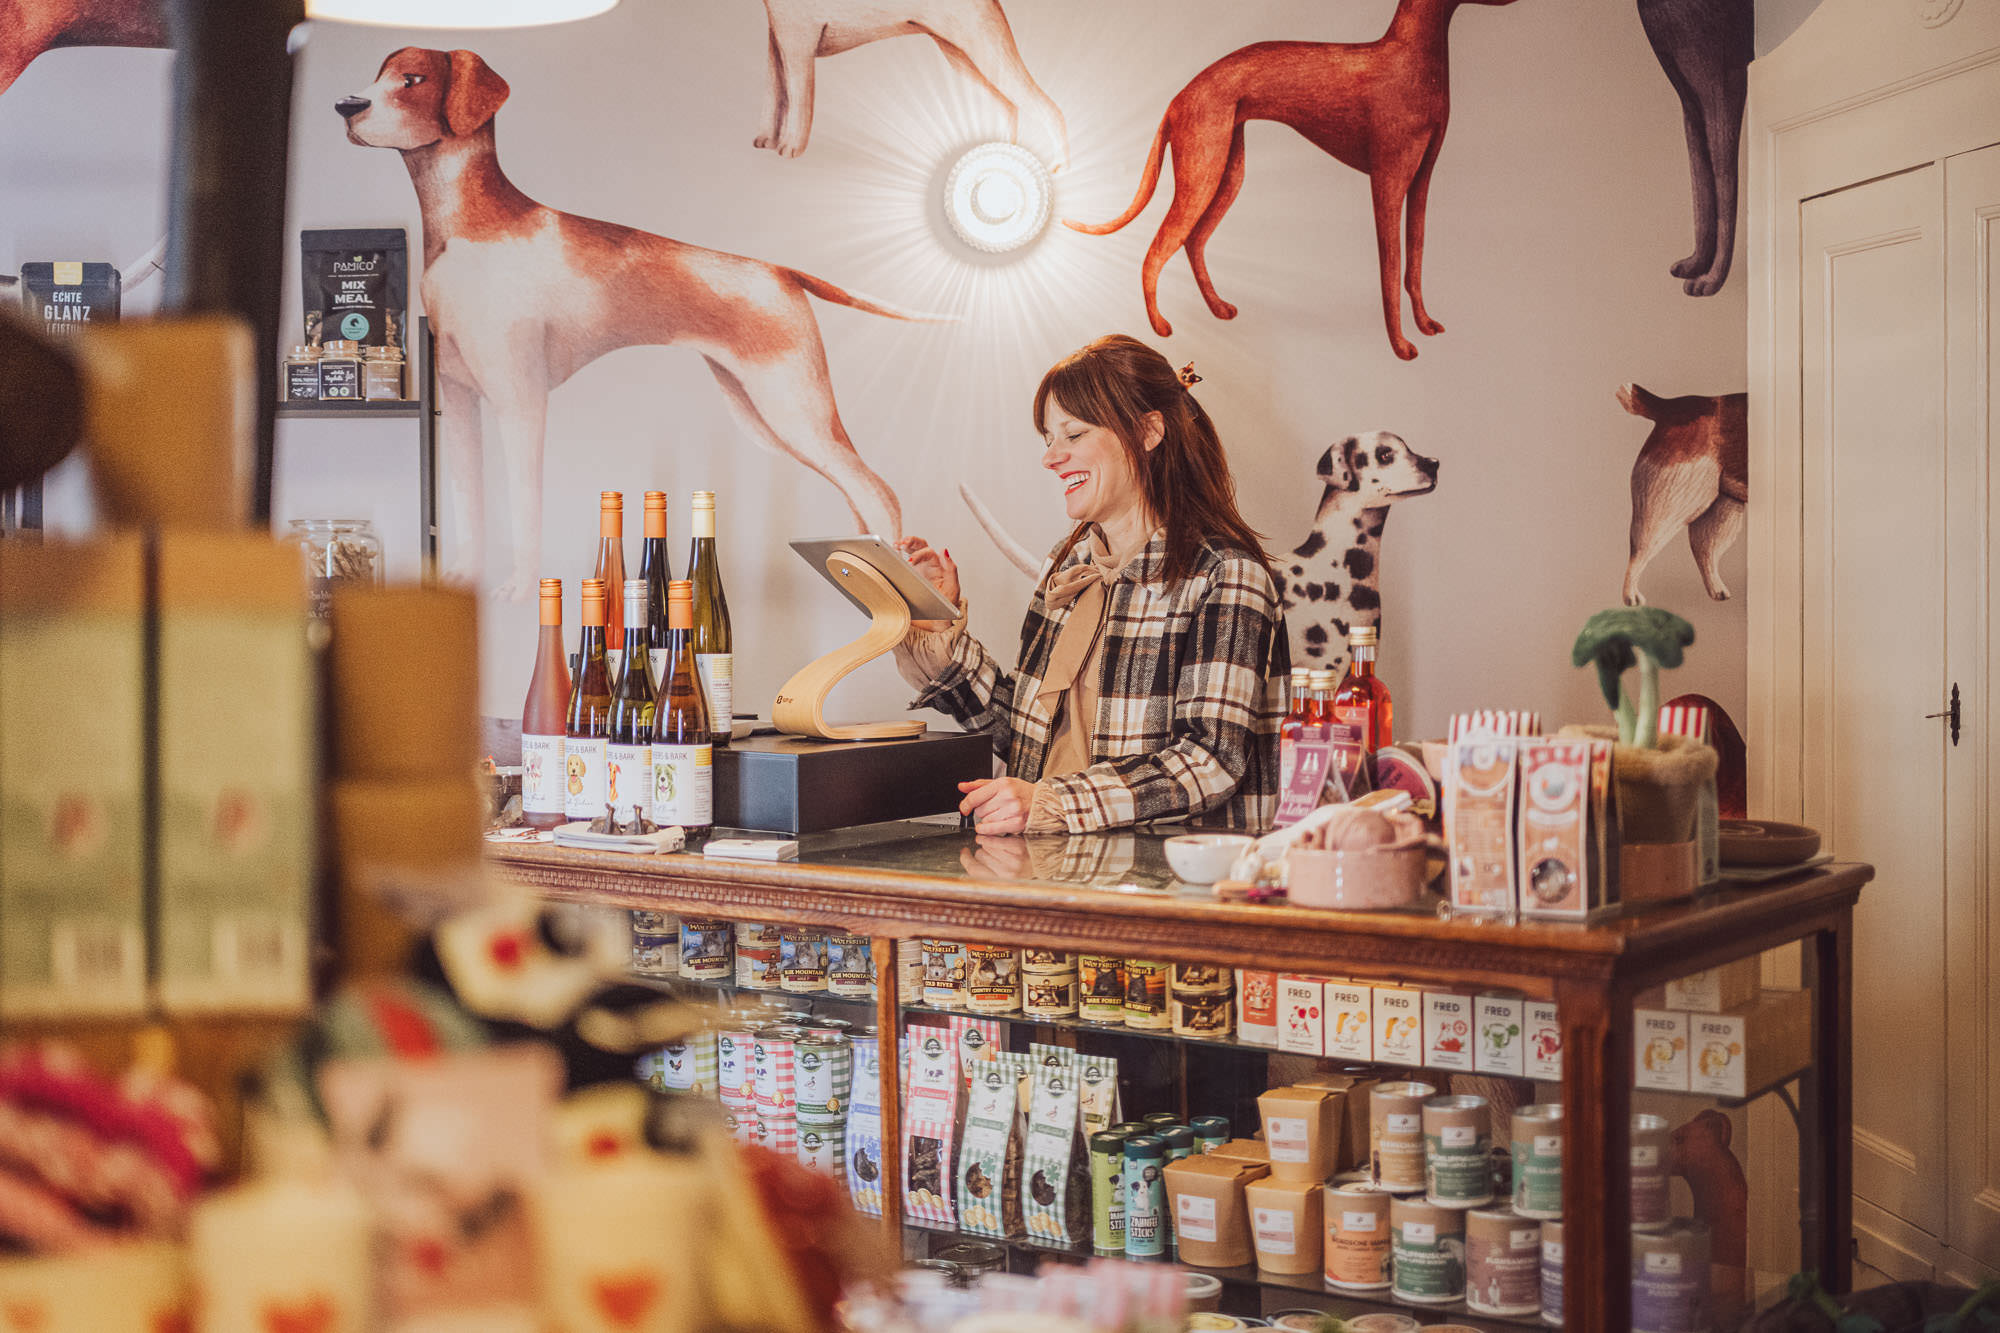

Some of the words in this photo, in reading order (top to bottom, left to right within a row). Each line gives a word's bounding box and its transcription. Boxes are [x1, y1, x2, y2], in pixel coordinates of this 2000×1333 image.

[333, 262, 374, 273] PAMICO
[341, 280, 366, 290] MIX
[52, 291, 82, 303] ECHTE
[334, 293, 374, 304] MEAL
[44, 305, 91, 321] GLANZ
[581, 744, 598, 753] BARK
[619, 751, 635, 760] BARK
[670, 751, 688, 760] BARK
[795, 968, 824, 976] MOUNTAIN
[1287, 988, 1312, 999] FRED
[1334, 993, 1360, 1003] FRED
[1383, 997, 1409, 1008] FRED
[1433, 1000, 1460, 1012] FRED
[1484, 1005, 1511, 1017] FRED
[1534, 1010, 1553, 1021] FRE
[1645, 1019, 1675, 1030] FRED
[1701, 1023, 1731, 1035] FRED
[1131, 1227, 1154, 1238] STICKS
